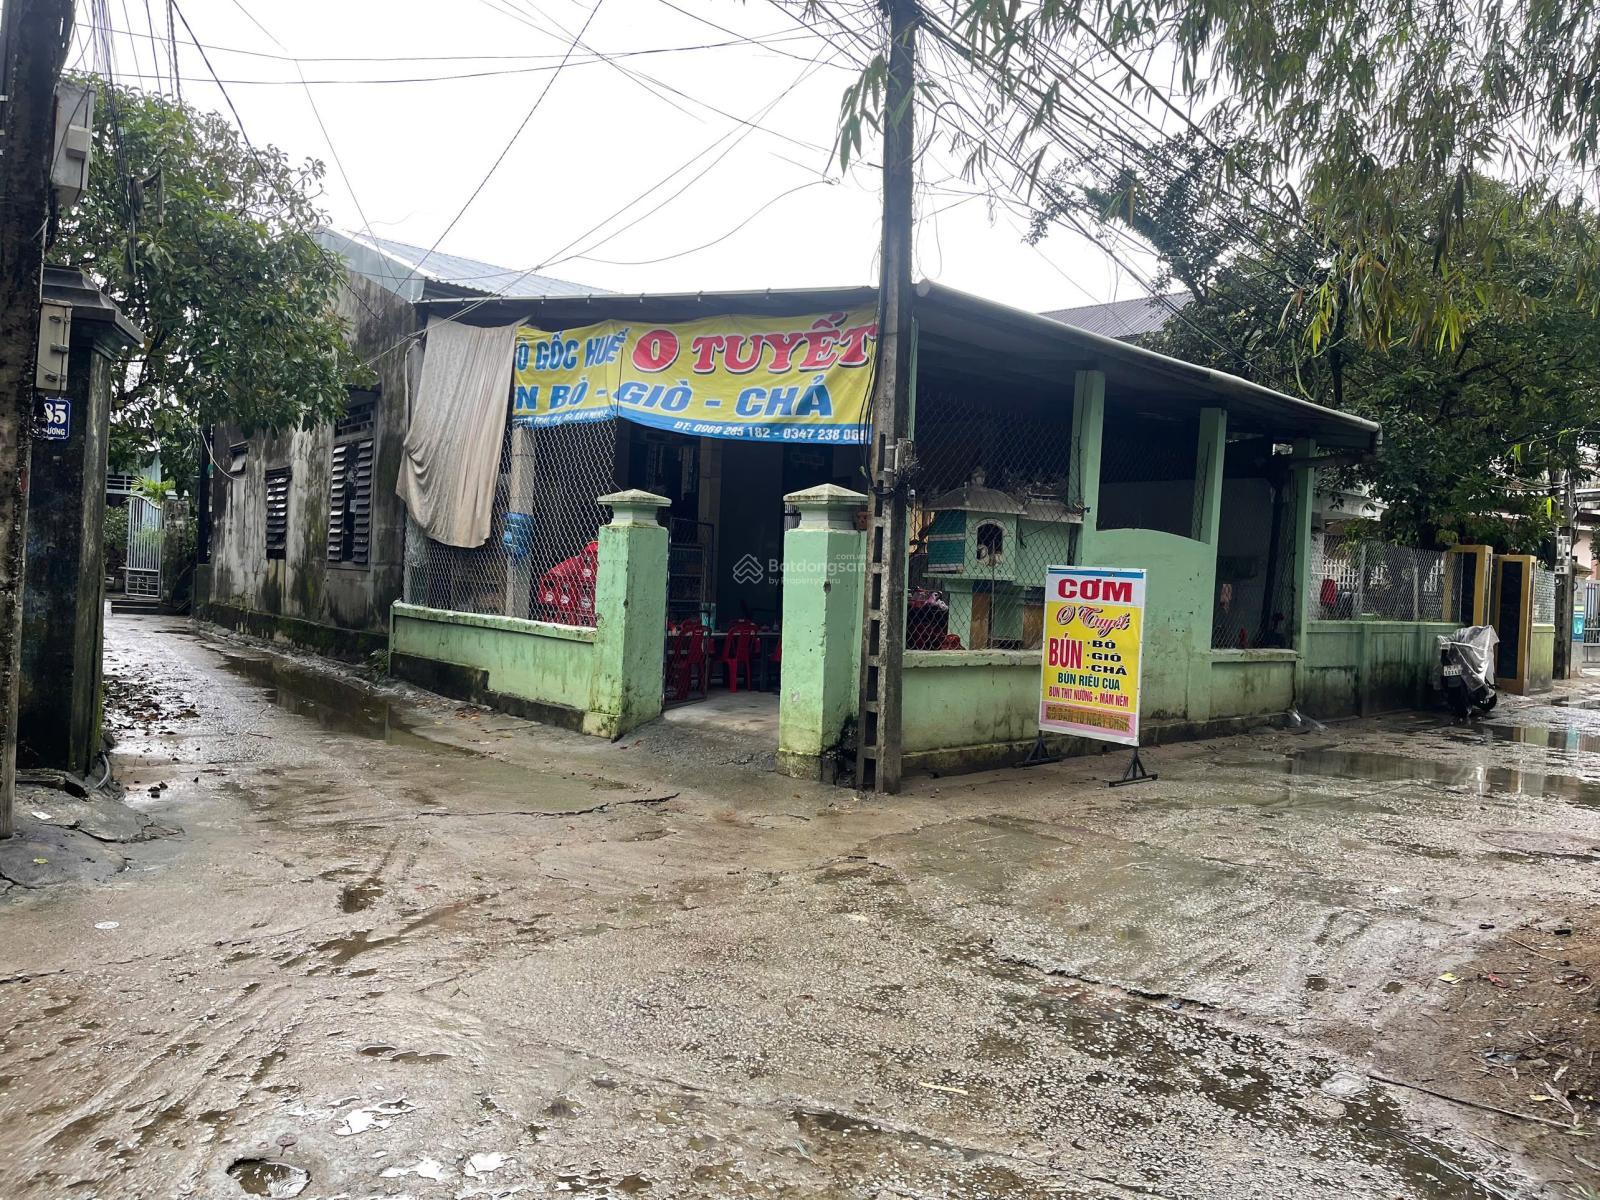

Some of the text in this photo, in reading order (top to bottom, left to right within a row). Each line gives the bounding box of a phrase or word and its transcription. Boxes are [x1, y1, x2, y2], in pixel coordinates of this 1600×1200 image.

[535, 330, 579, 370] GỐC
[584, 328, 631, 367] HUẾ
[632, 311, 878, 375] O TUYẾT
[613, 379, 692, 412] GIÒ
[735, 374, 833, 418] CHẢ
[723, 426, 744, 437] 285
[748, 427, 770, 438] 182
[783, 428, 814, 440] 0347
[817, 429, 839, 440] 238
[1058, 578, 1133, 603] CƠM
[1056, 605, 1130, 638] O Tuyết
[1048, 633, 1082, 669] BÚN
[1058, 670, 1120, 691] BÚN RIÊU CUA
